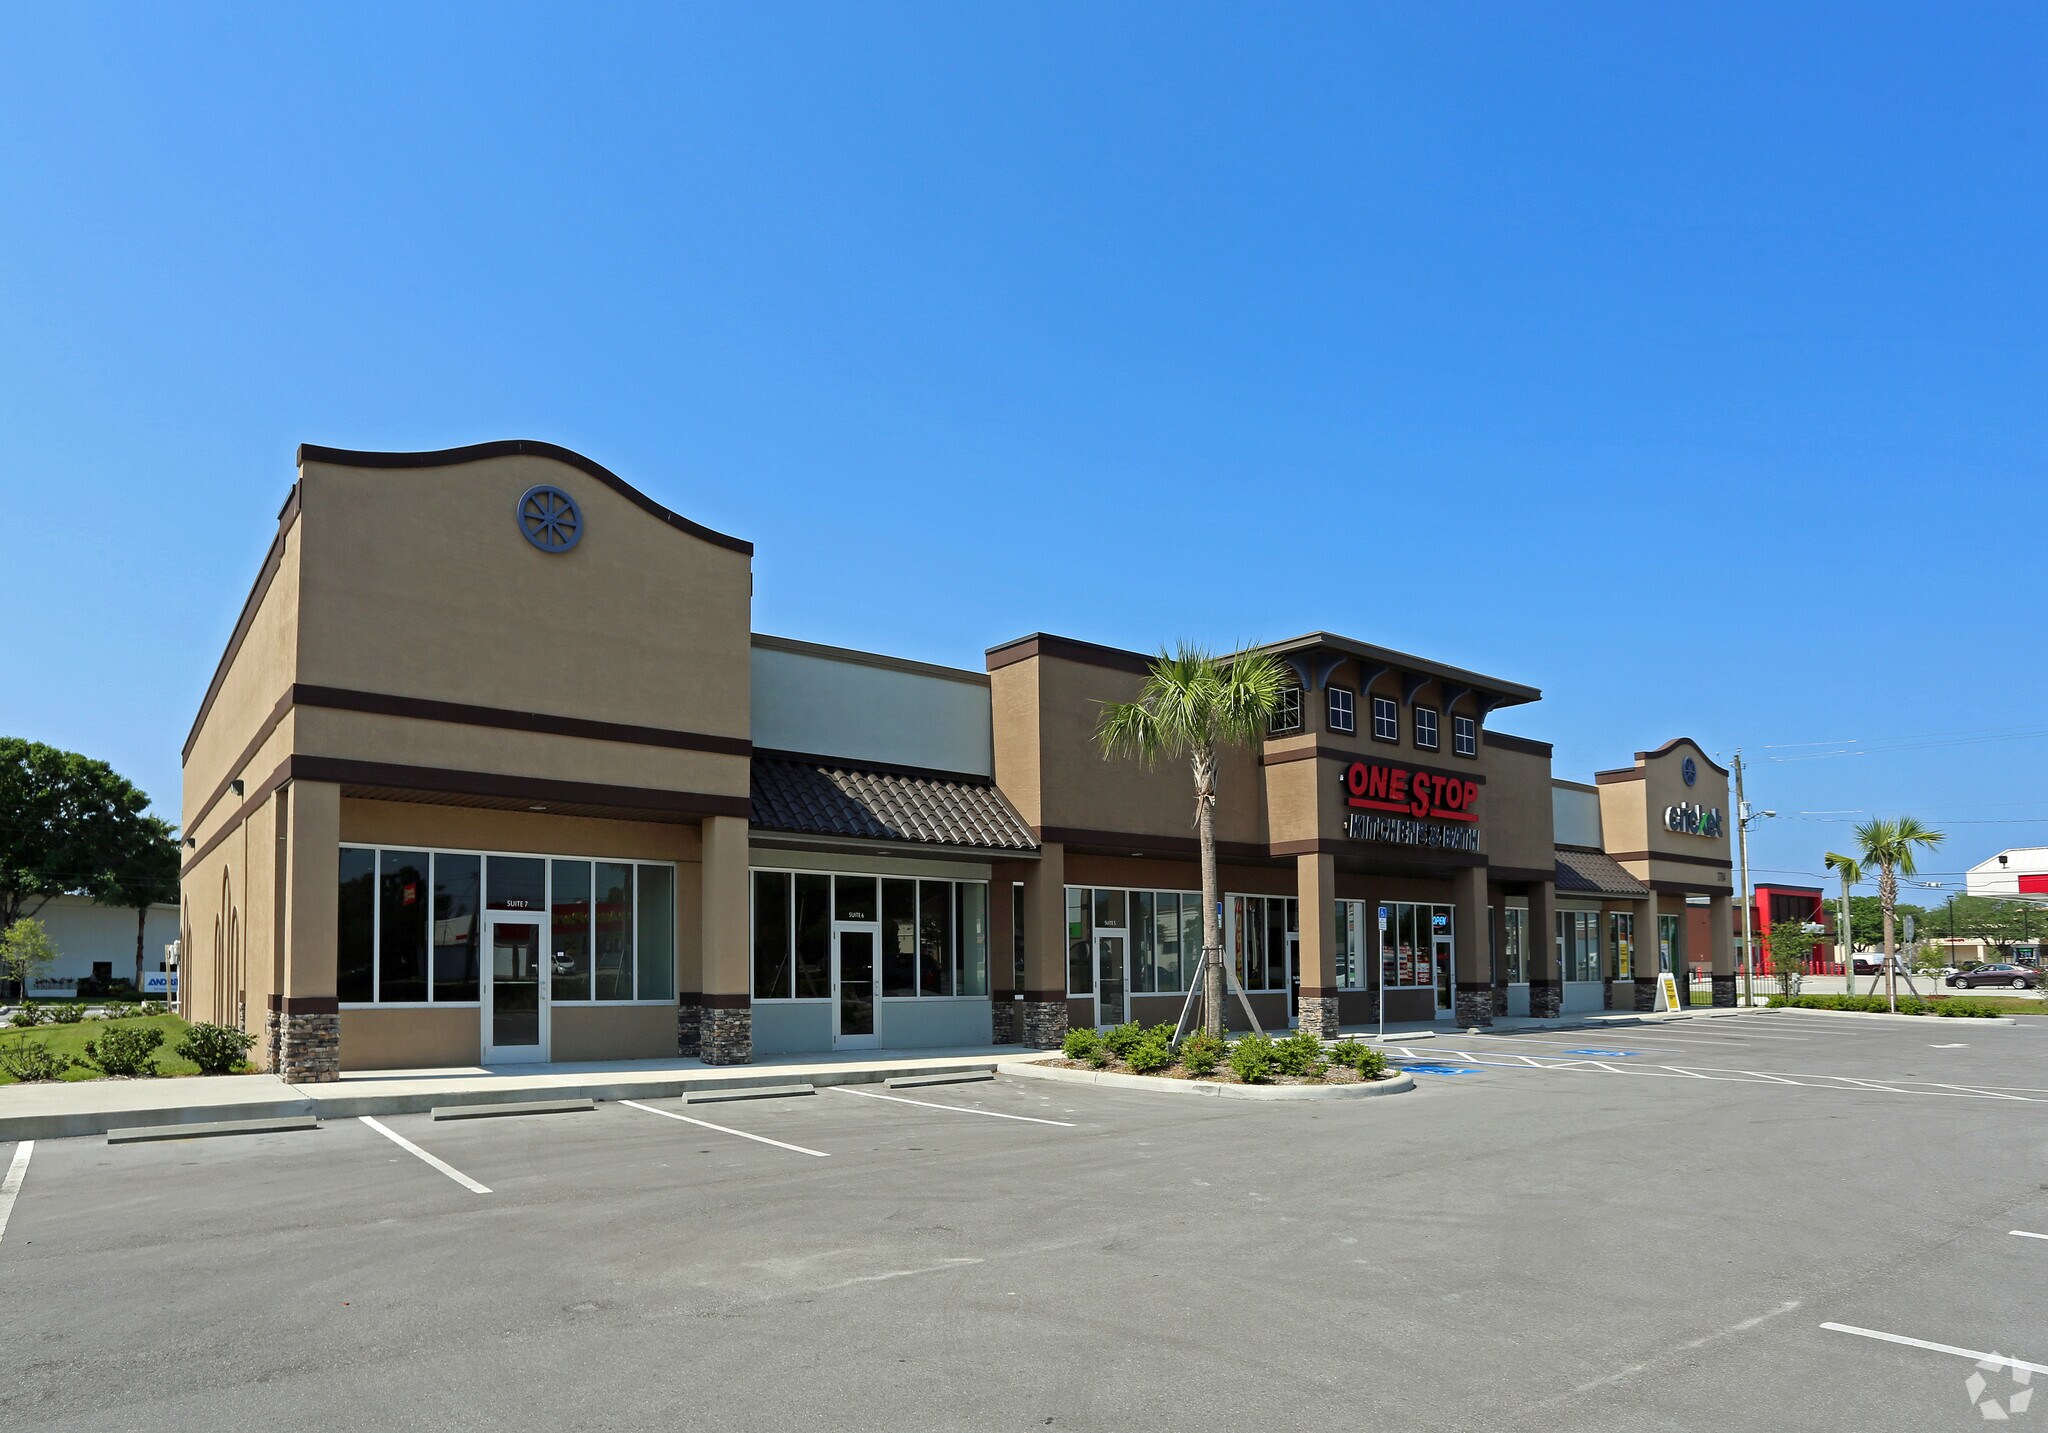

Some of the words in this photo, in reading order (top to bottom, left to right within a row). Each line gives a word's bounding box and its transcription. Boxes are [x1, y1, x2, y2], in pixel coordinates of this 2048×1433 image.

[1348, 761, 1408, 800] ONE
[1411, 771, 1479, 818] STOP
[1664, 801, 1723, 838] cricket
[1350, 813, 1428, 846] KITCHENS
[1428, 823, 1442, 847] &
[1443, 825, 1481, 851] BATH
[507, 900, 523, 908] SUITE
[848, 911, 861, 919] SUITE
[1432, 916, 1447, 926] OPEN
